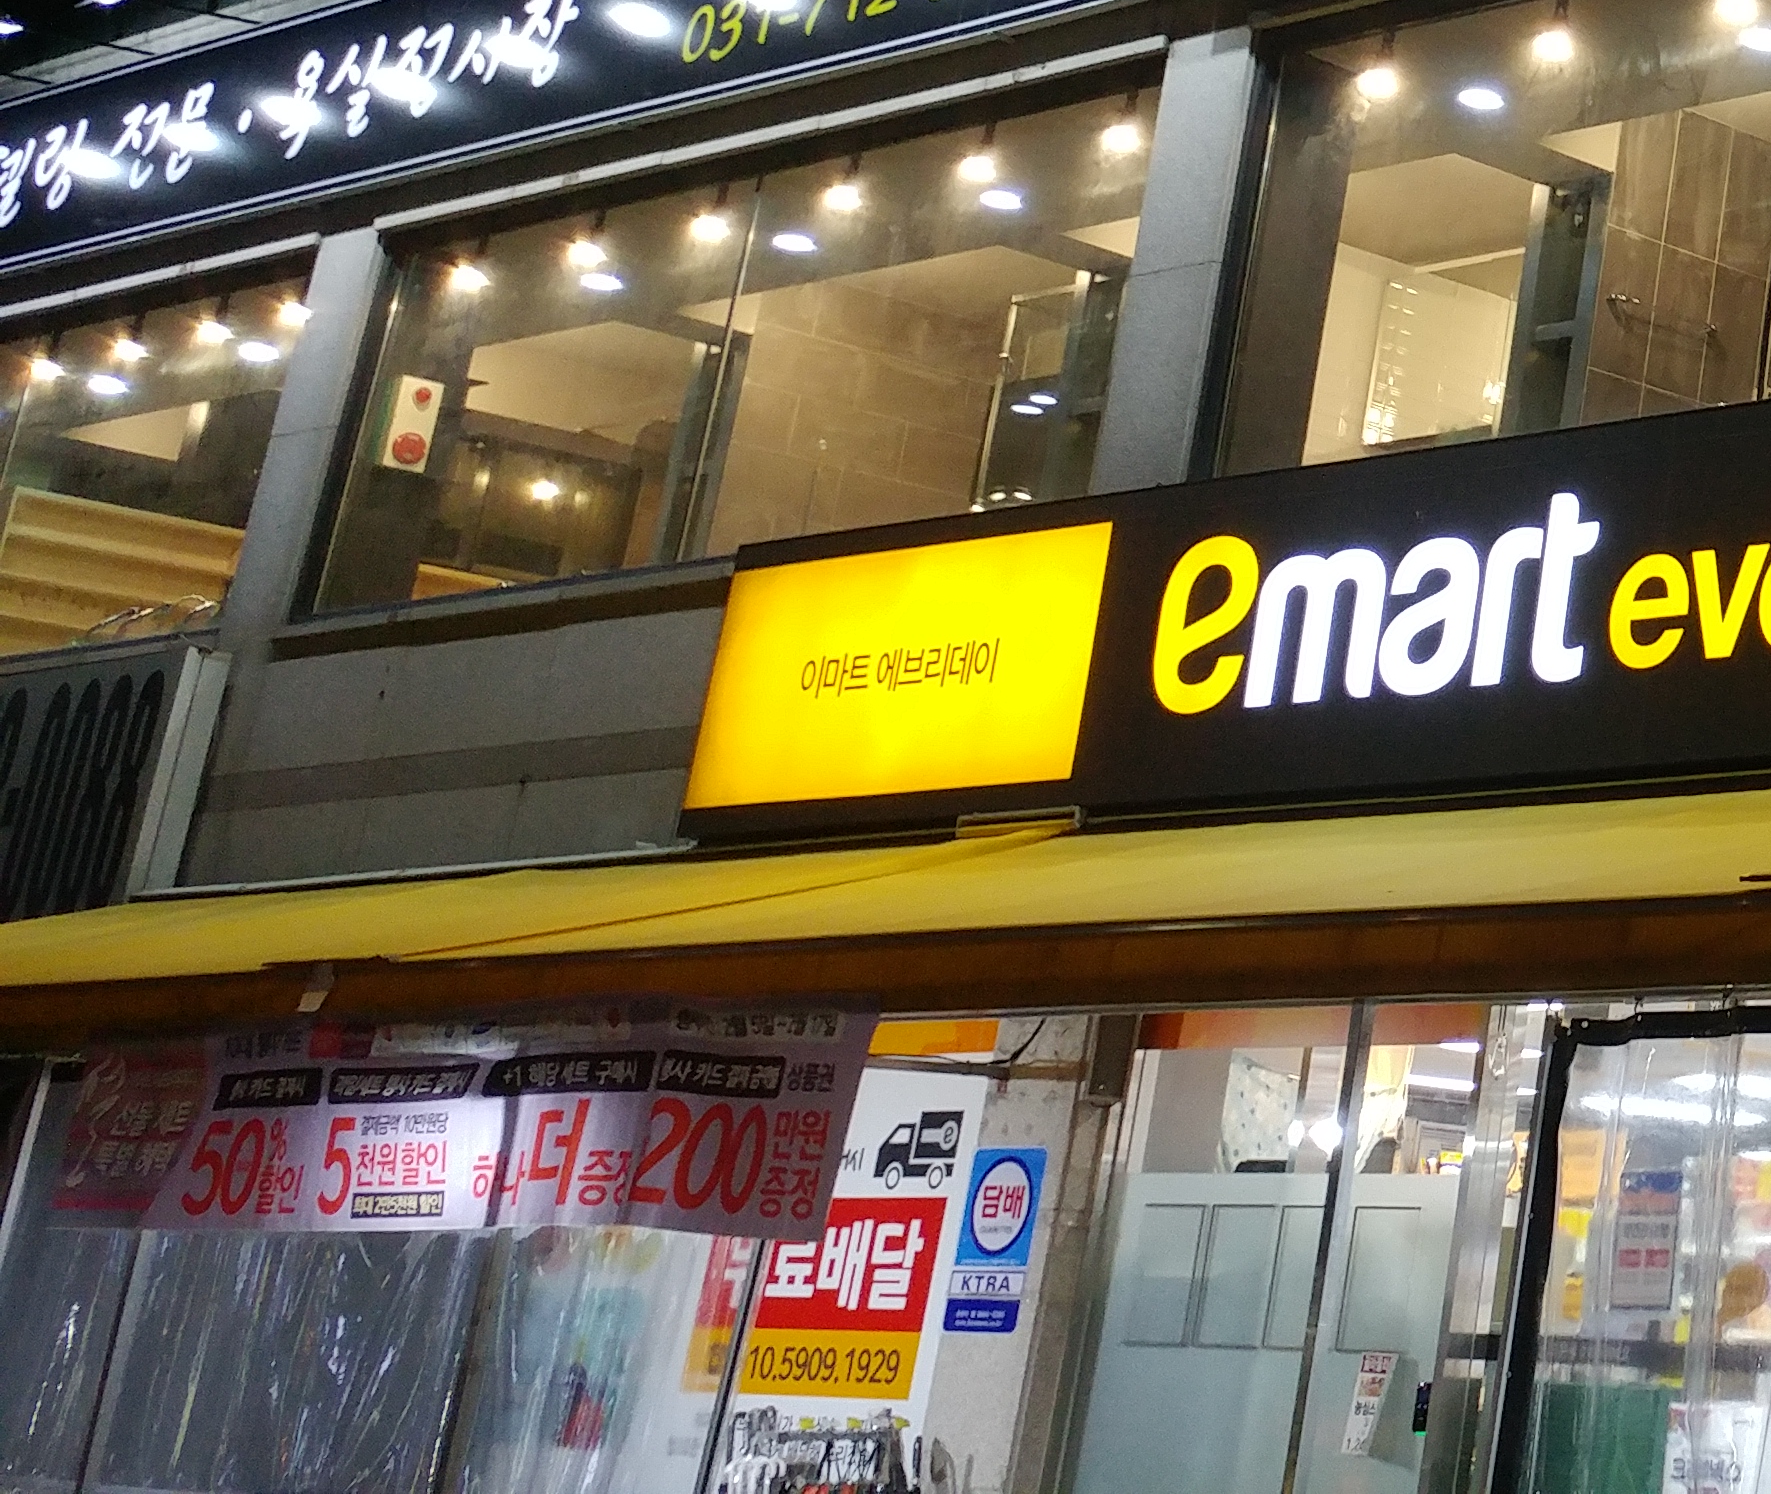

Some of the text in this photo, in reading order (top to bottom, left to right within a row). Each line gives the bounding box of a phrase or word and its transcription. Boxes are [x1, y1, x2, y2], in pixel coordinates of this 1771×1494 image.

[1152, 492, 1601, 716] emart
[801, 637, 1001, 700] 이마트 에브리데이
[526, 1097, 592, 1206] 더
[980, 1183, 1026, 1220] 담배
[960, 1274, 1011, 1293] KTRA
